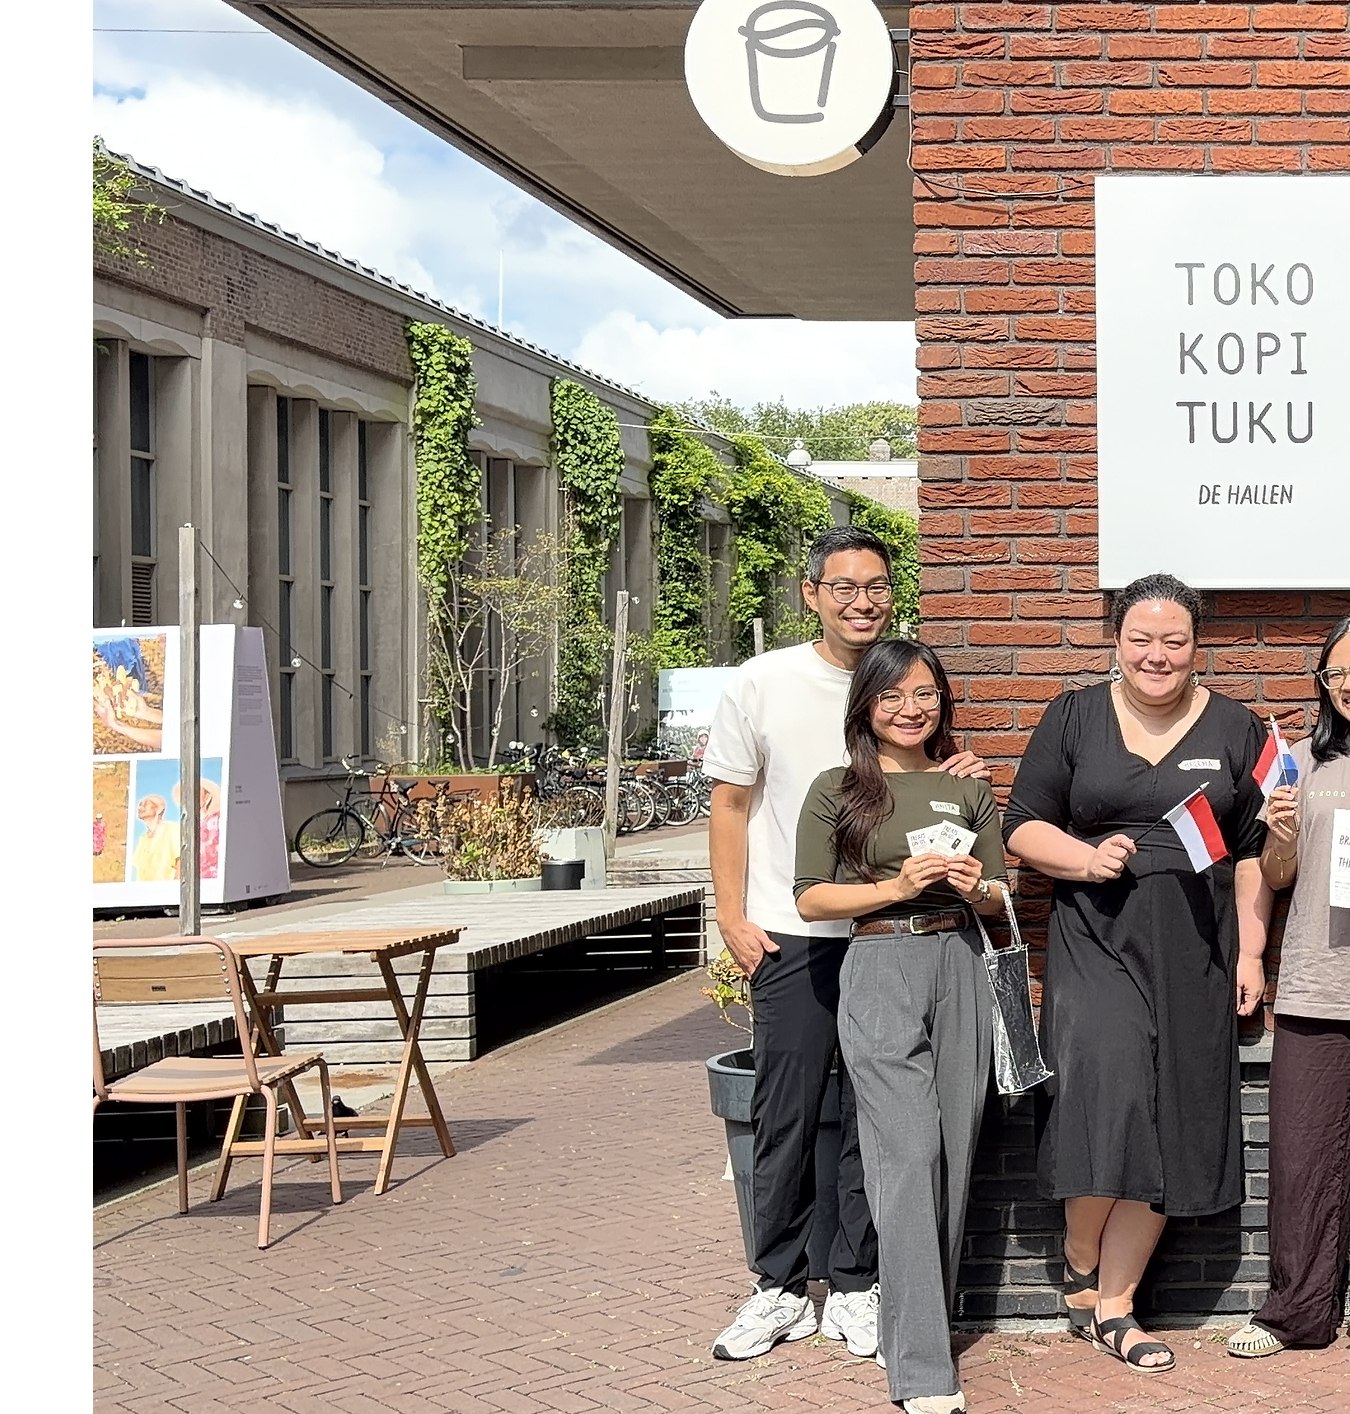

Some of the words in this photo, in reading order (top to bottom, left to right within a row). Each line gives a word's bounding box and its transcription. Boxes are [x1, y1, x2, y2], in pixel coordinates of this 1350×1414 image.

[1174, 262, 1314, 306] TOKO
[1179, 332, 1308, 375] KOPI
[1175, 401, 1314, 444] TUKU
[1198, 484, 1221, 505] DE
[1227, 484, 1294, 505] HALLEN
[935, 803, 957, 812] ANITA
